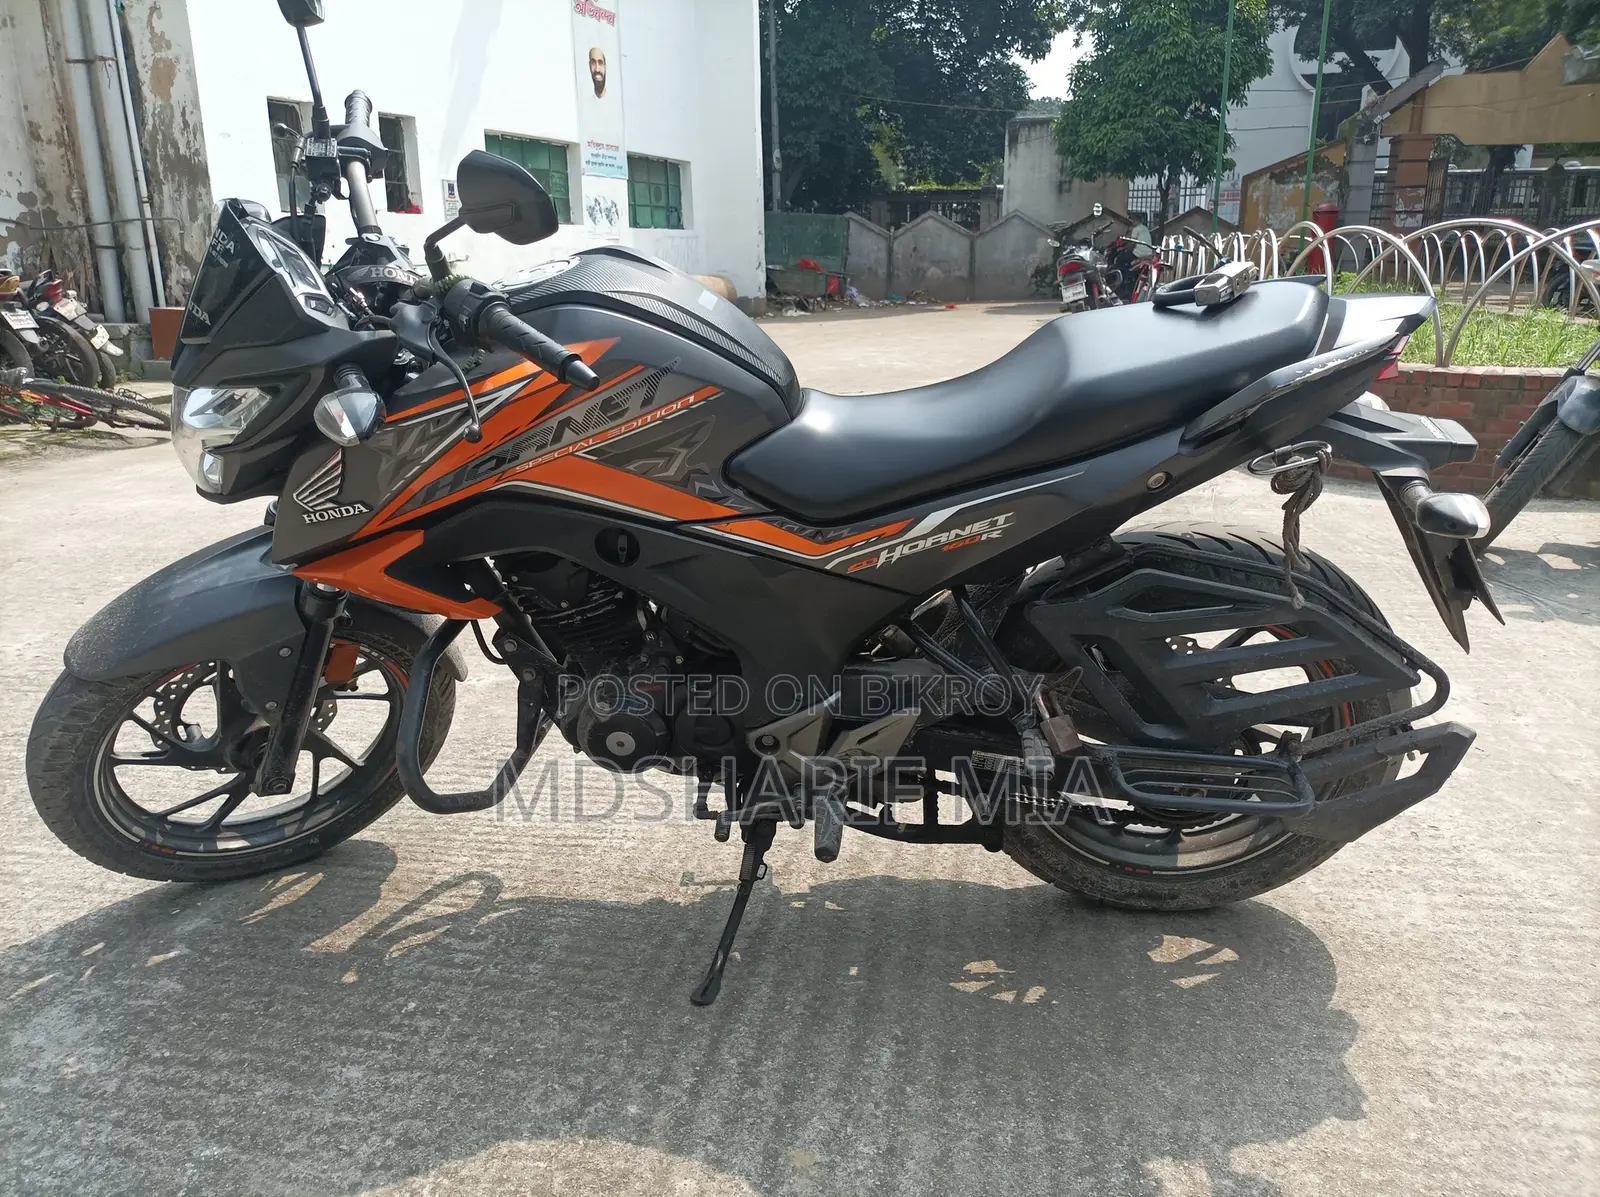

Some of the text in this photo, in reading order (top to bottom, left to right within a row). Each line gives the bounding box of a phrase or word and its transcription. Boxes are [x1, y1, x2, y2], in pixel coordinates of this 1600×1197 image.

[371, 267, 419, 283] HOND
[515, 394, 696, 473] SPECIAL EDITION
[302, 503, 369, 524] HONDA
[876, 512, 1015, 569] HORNET
